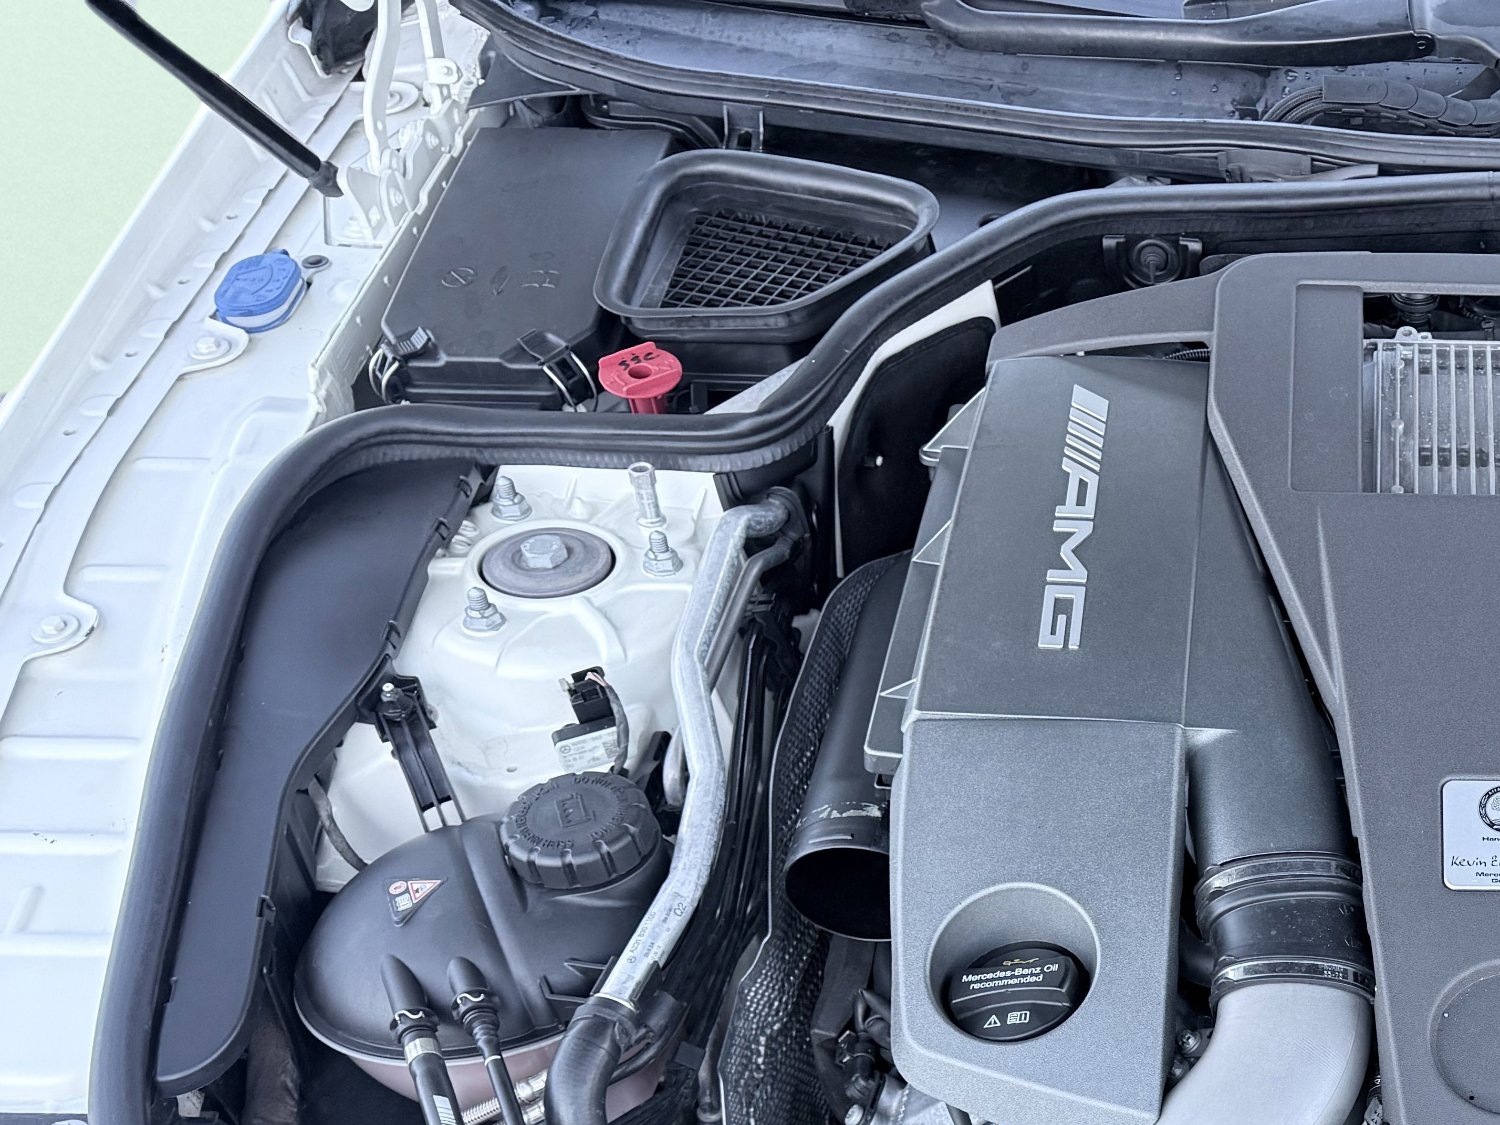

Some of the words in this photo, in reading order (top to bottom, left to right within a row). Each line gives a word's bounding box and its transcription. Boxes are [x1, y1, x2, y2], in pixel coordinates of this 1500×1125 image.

[1038, 457, 1099, 649] AMG
[1451, 856, 1487, 867] Kevin
[962, 966, 1042, 982] Mercedes-Benz
[1044, 964, 1058, 972] Oil
[970, 974, 1043, 990] recommended
